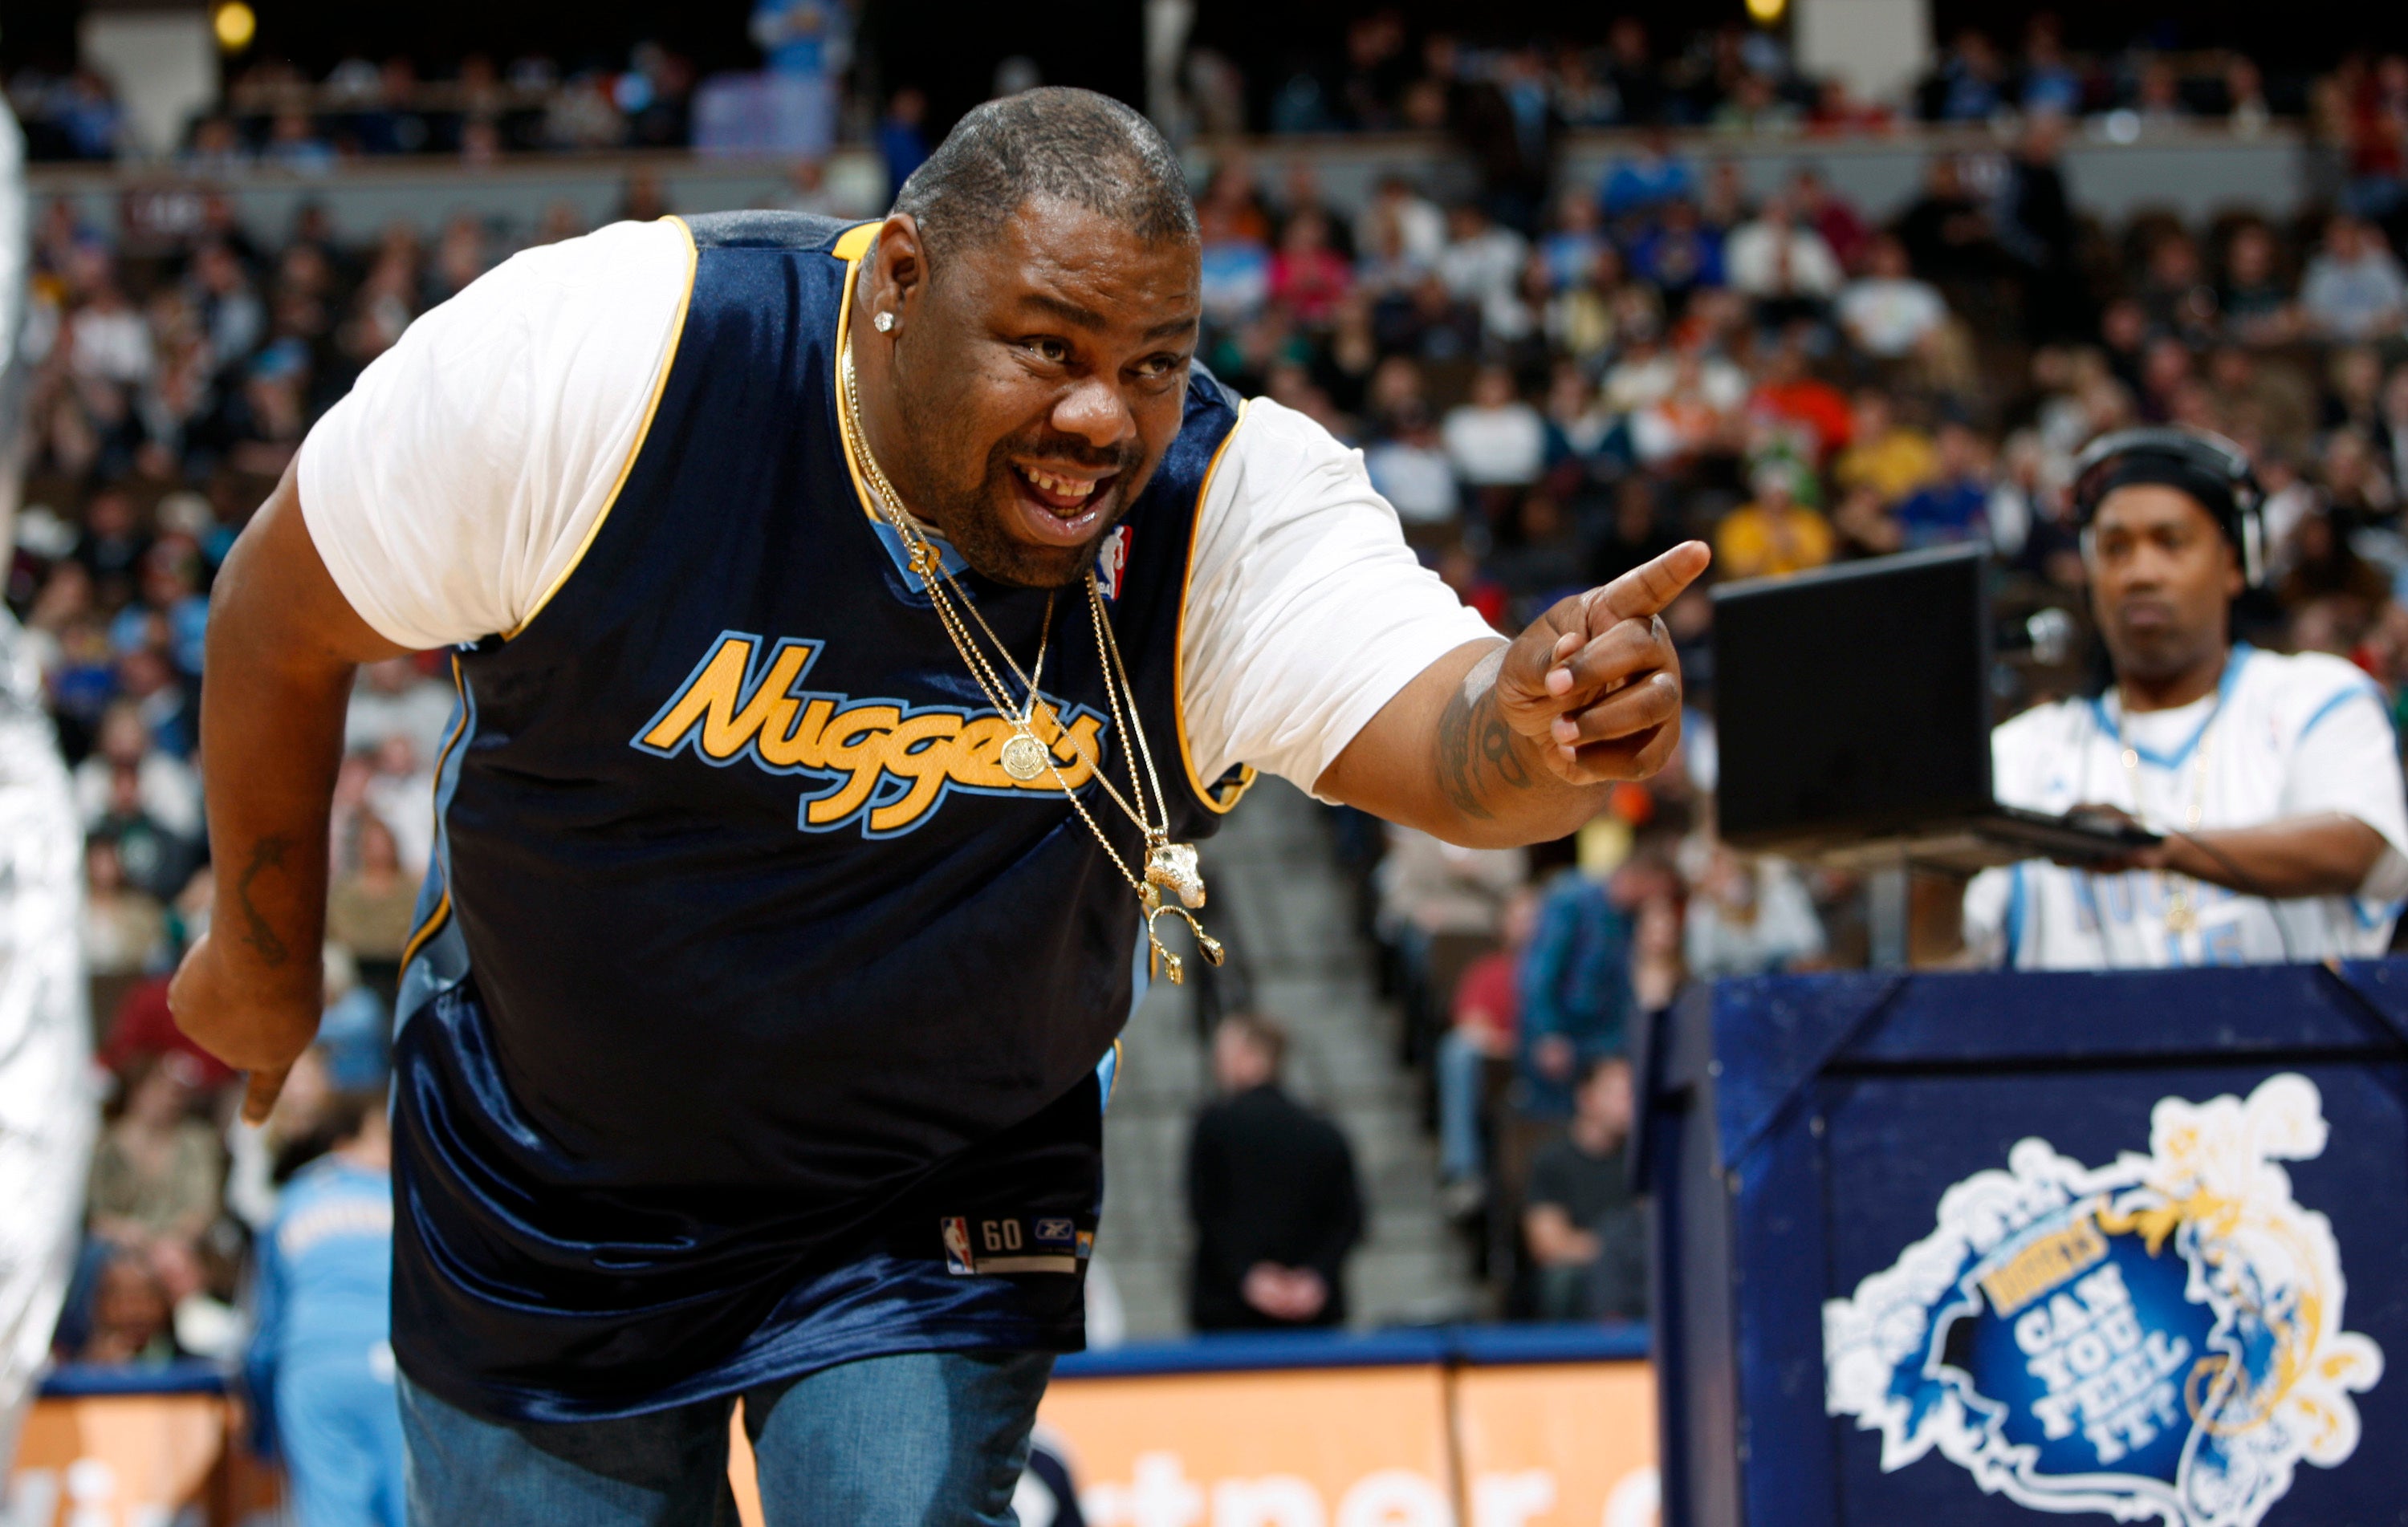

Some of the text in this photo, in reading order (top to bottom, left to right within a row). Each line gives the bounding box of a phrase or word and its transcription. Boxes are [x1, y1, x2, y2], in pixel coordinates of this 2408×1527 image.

[630, 630, 1108, 839] Nuggets
[982, 1218, 1023, 1251] 60
[2014, 1261, 2131, 1356] CAN
[2026, 1306, 2142, 1394] YOU
[2030, 1329, 2192, 1441] FEEL
